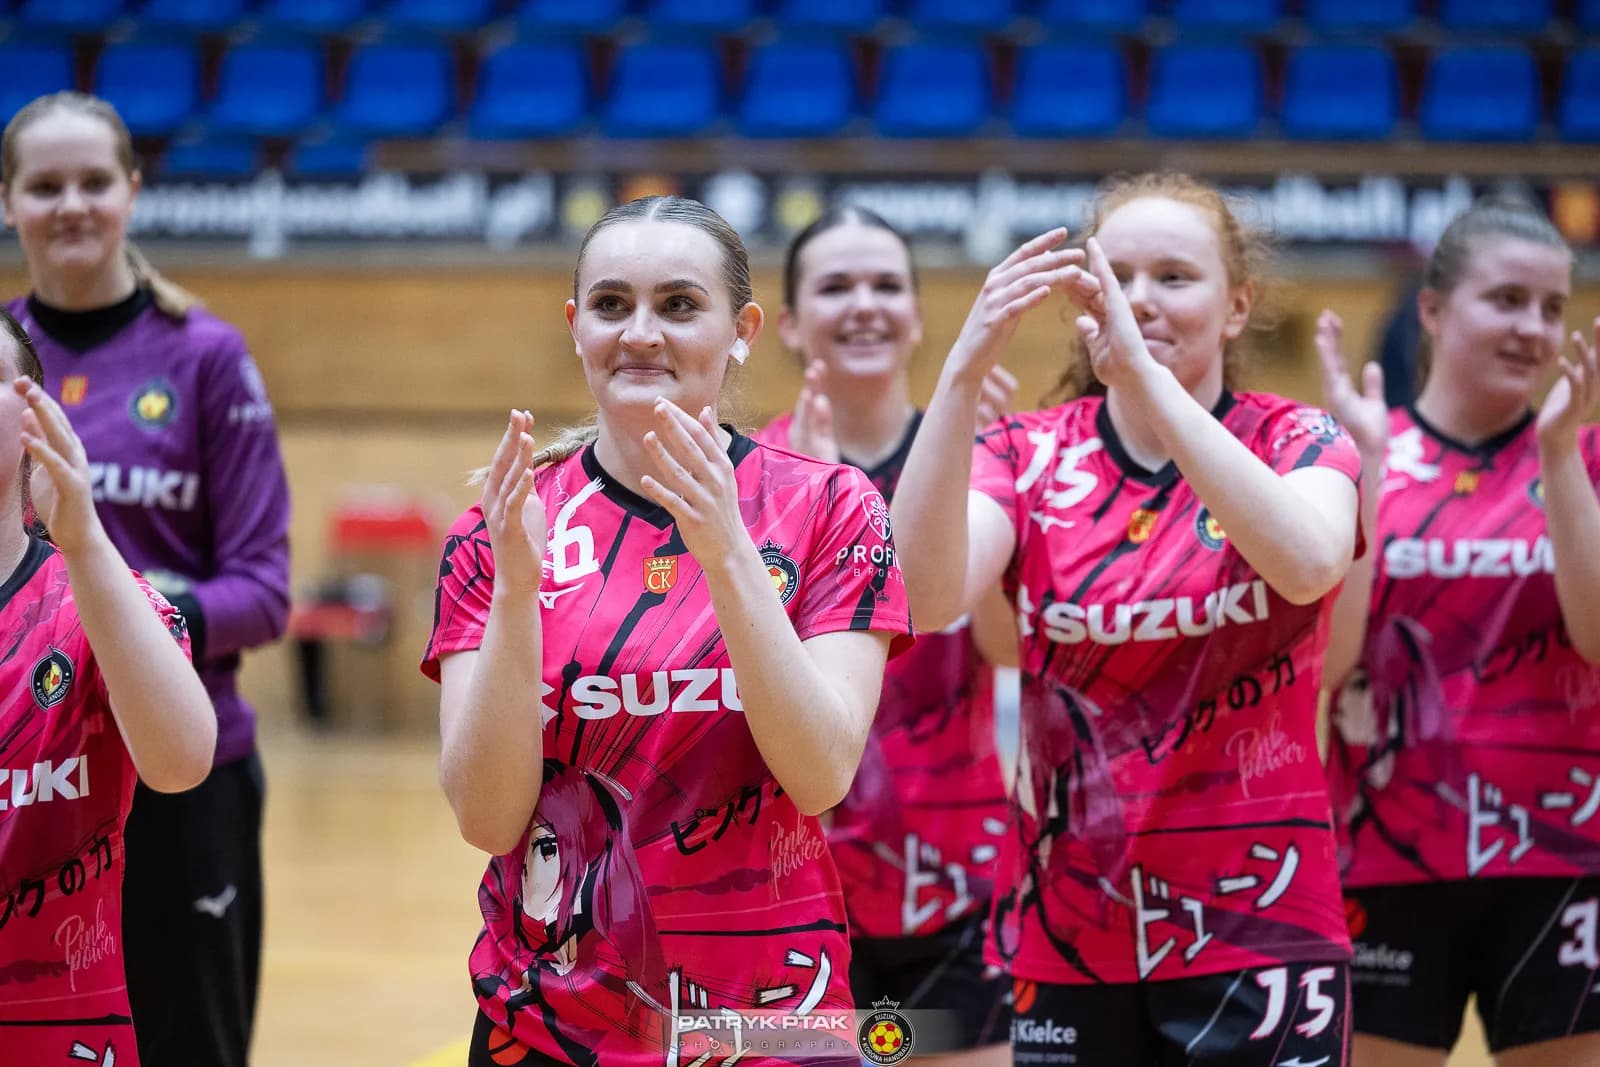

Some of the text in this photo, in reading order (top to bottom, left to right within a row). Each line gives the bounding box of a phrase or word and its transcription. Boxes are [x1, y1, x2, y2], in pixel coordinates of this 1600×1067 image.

[1015, 430, 1103, 509] 15
[647, 569, 673, 590] CK
[1384, 536, 1556, 580] SUZU
[1043, 580, 1270, 646] SUZUKI
[54, 897, 106, 965] Pink
[68, 932, 117, 993] power
[1016, 1018, 1078, 1044] Kielce
[1249, 966, 1337, 1041] 15
